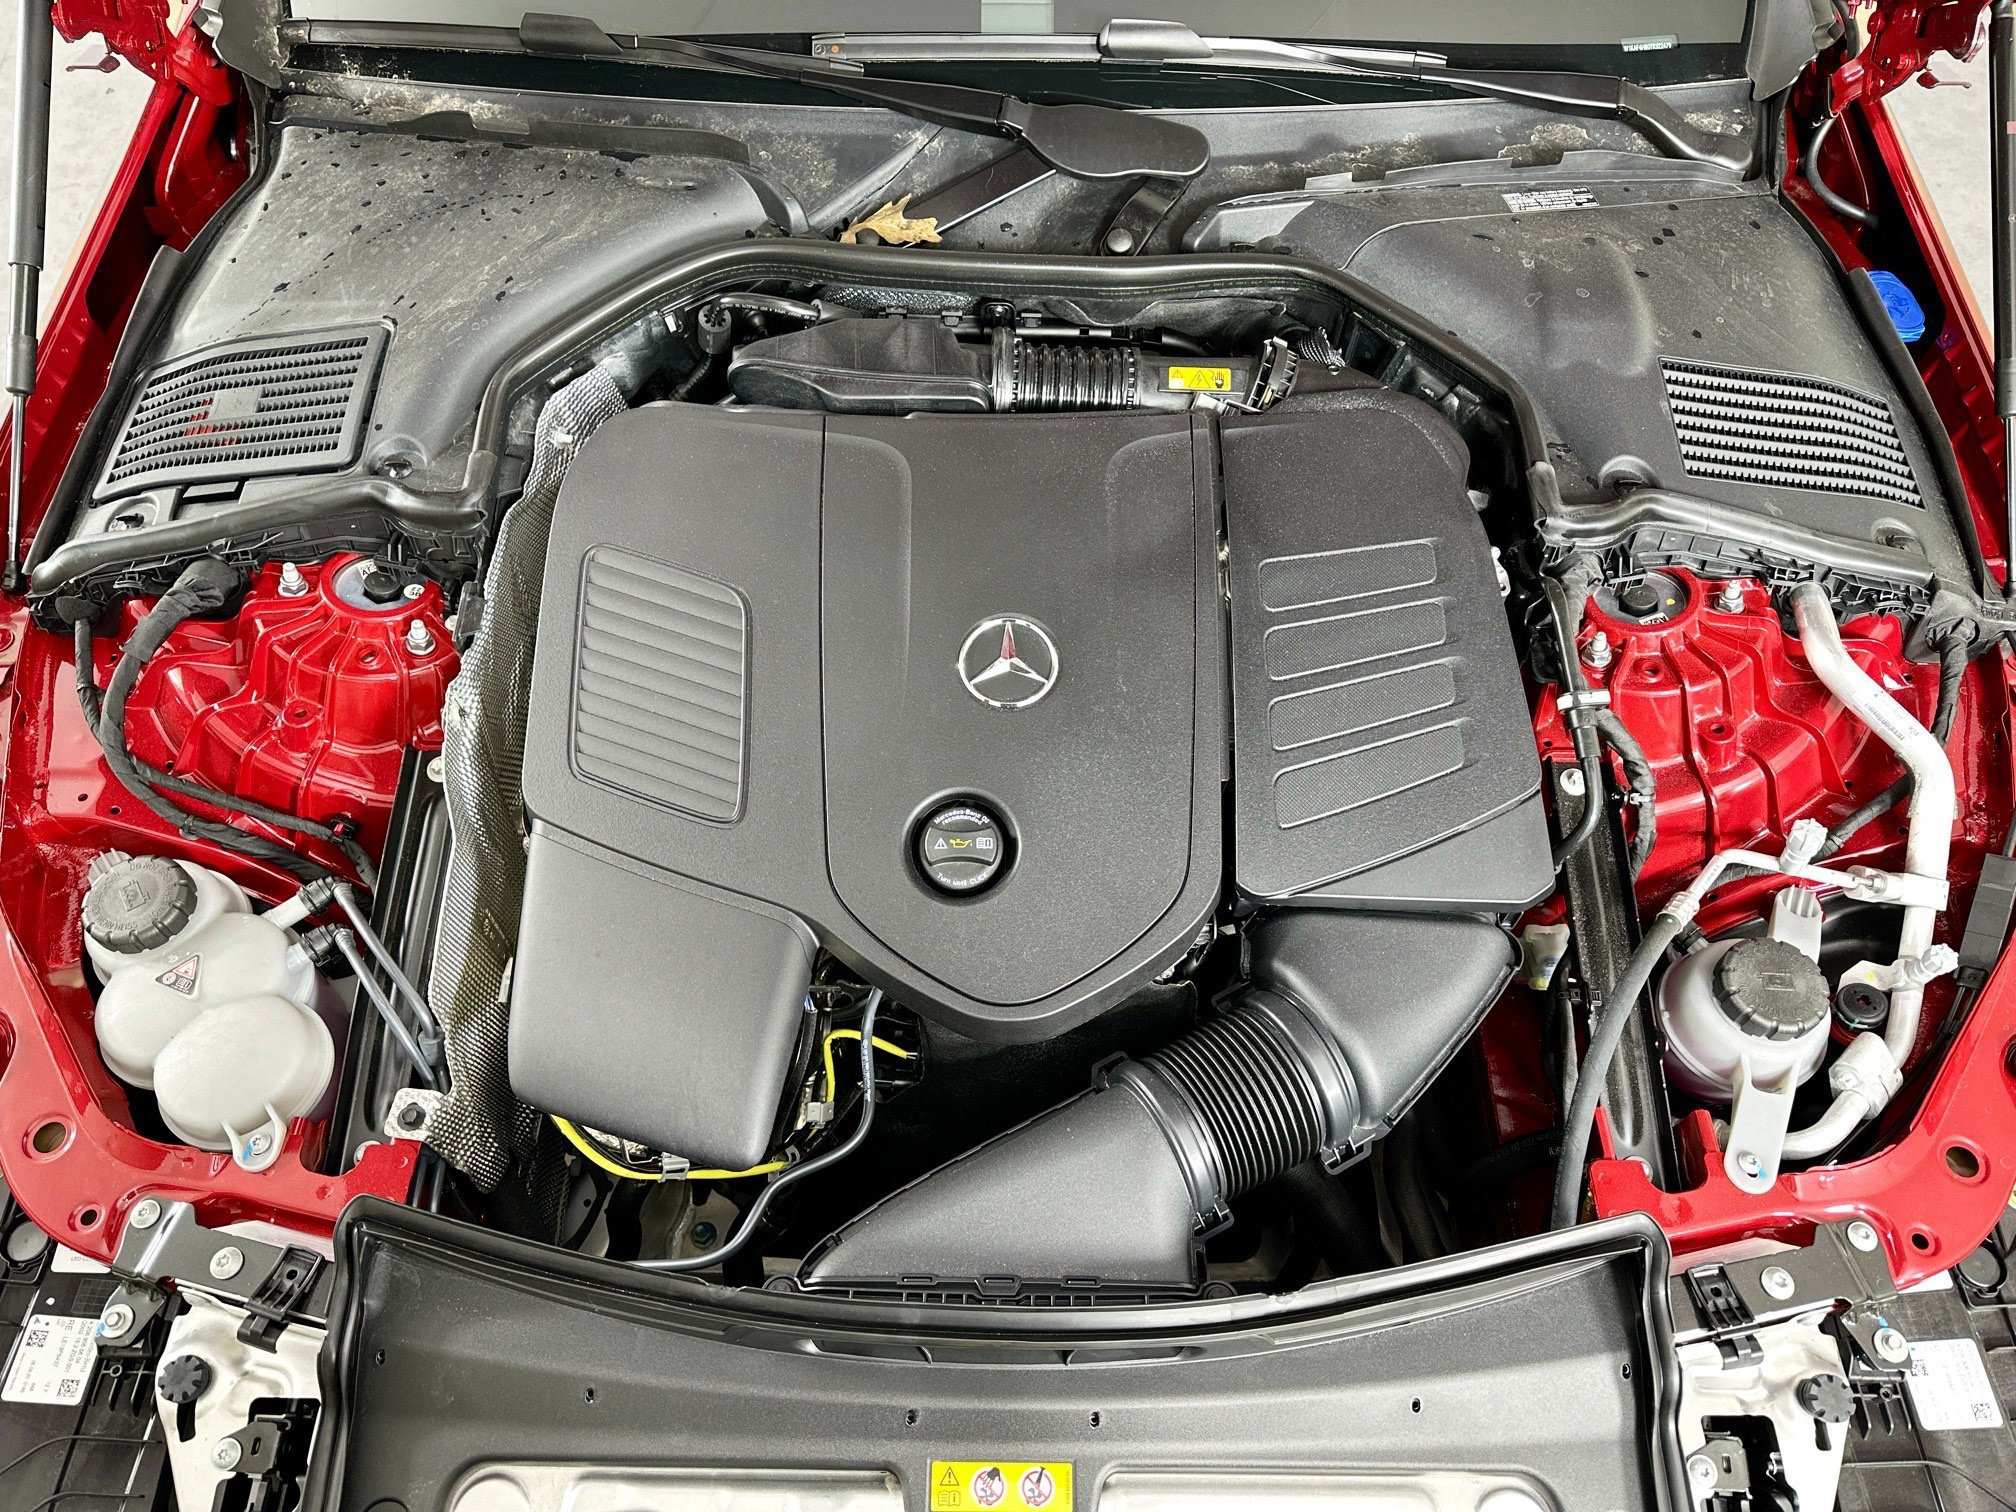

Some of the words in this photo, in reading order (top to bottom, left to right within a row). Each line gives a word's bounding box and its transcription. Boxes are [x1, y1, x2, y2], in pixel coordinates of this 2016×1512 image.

[934, 809, 981, 825] Mercedes-Benz
[942, 815, 983, 826] recommended
[937, 873, 951, 884] Turn
[970, 872, 989, 884] CLICK
[64, 1319, 74, 1330] RE
